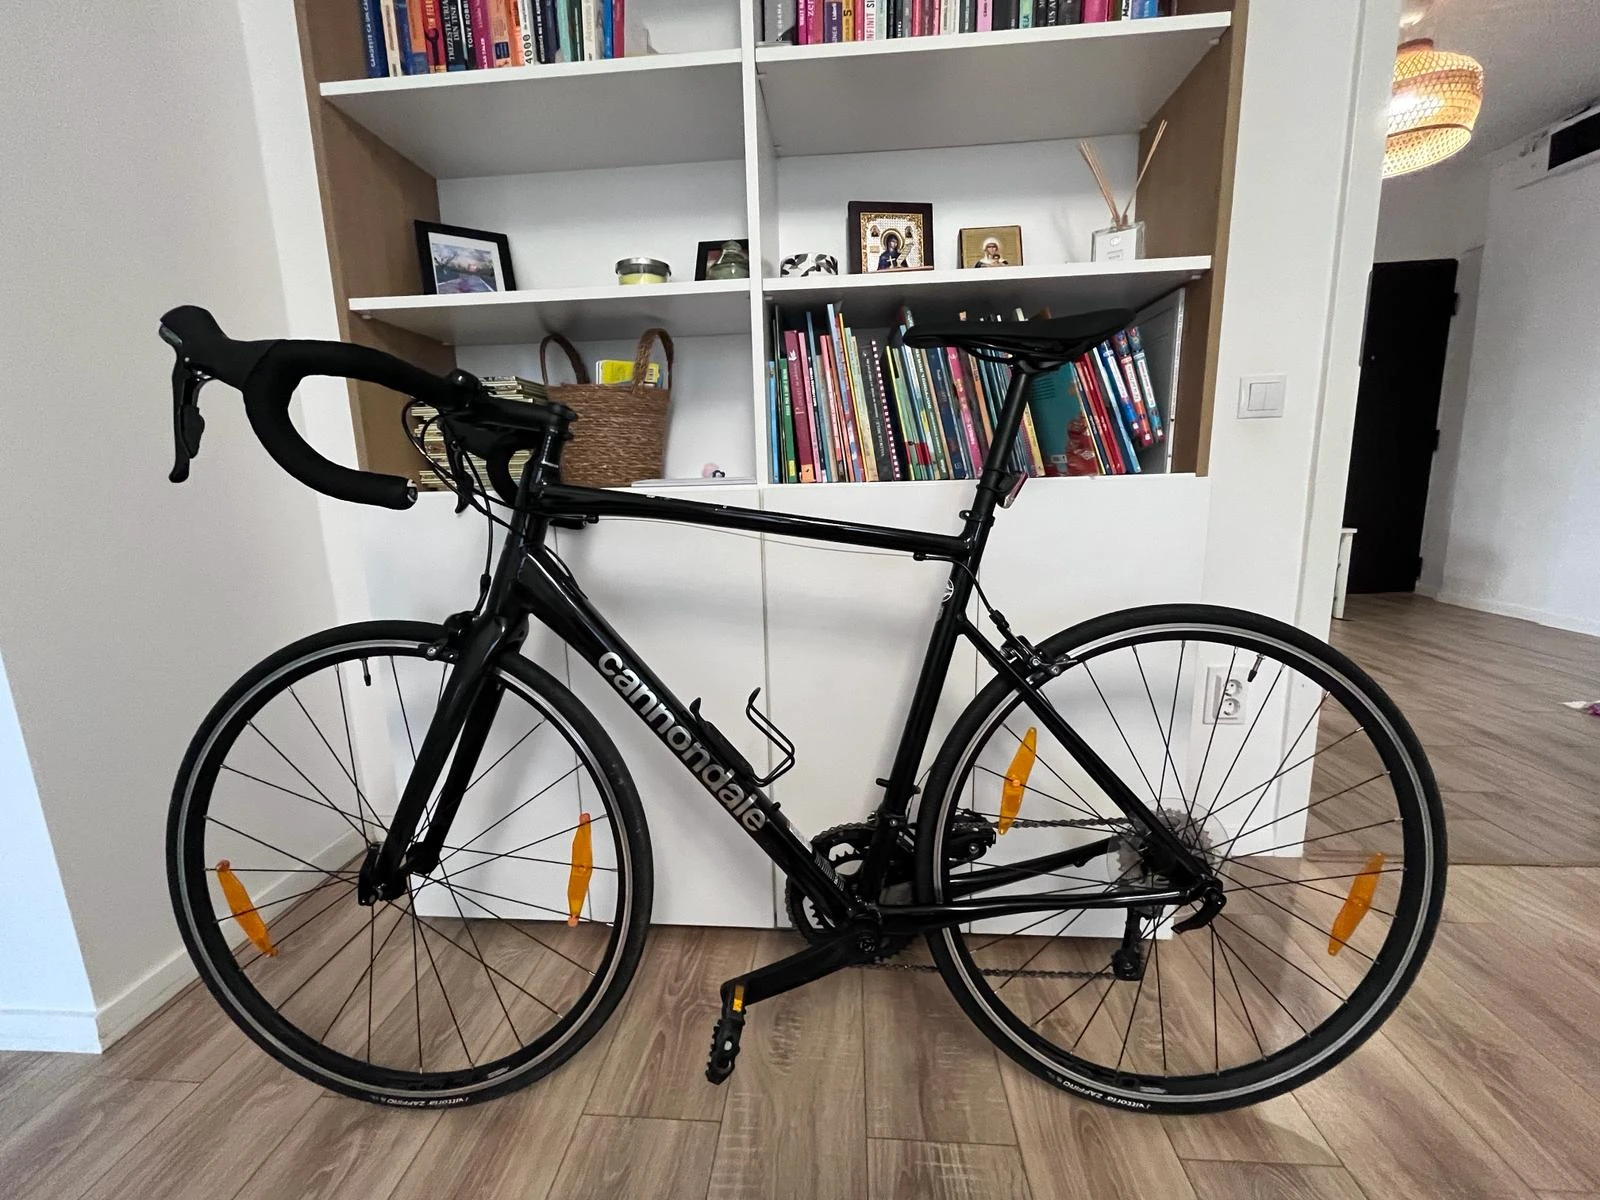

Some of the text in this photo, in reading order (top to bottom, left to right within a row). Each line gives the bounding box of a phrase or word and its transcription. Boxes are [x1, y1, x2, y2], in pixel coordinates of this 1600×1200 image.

[466, 27, 474, 48] TONY
[523, 34, 533, 64] 4000
[599, 651, 768, 832] cannondale
[1062, 1080, 1104, 1099] ZAFFIRO
